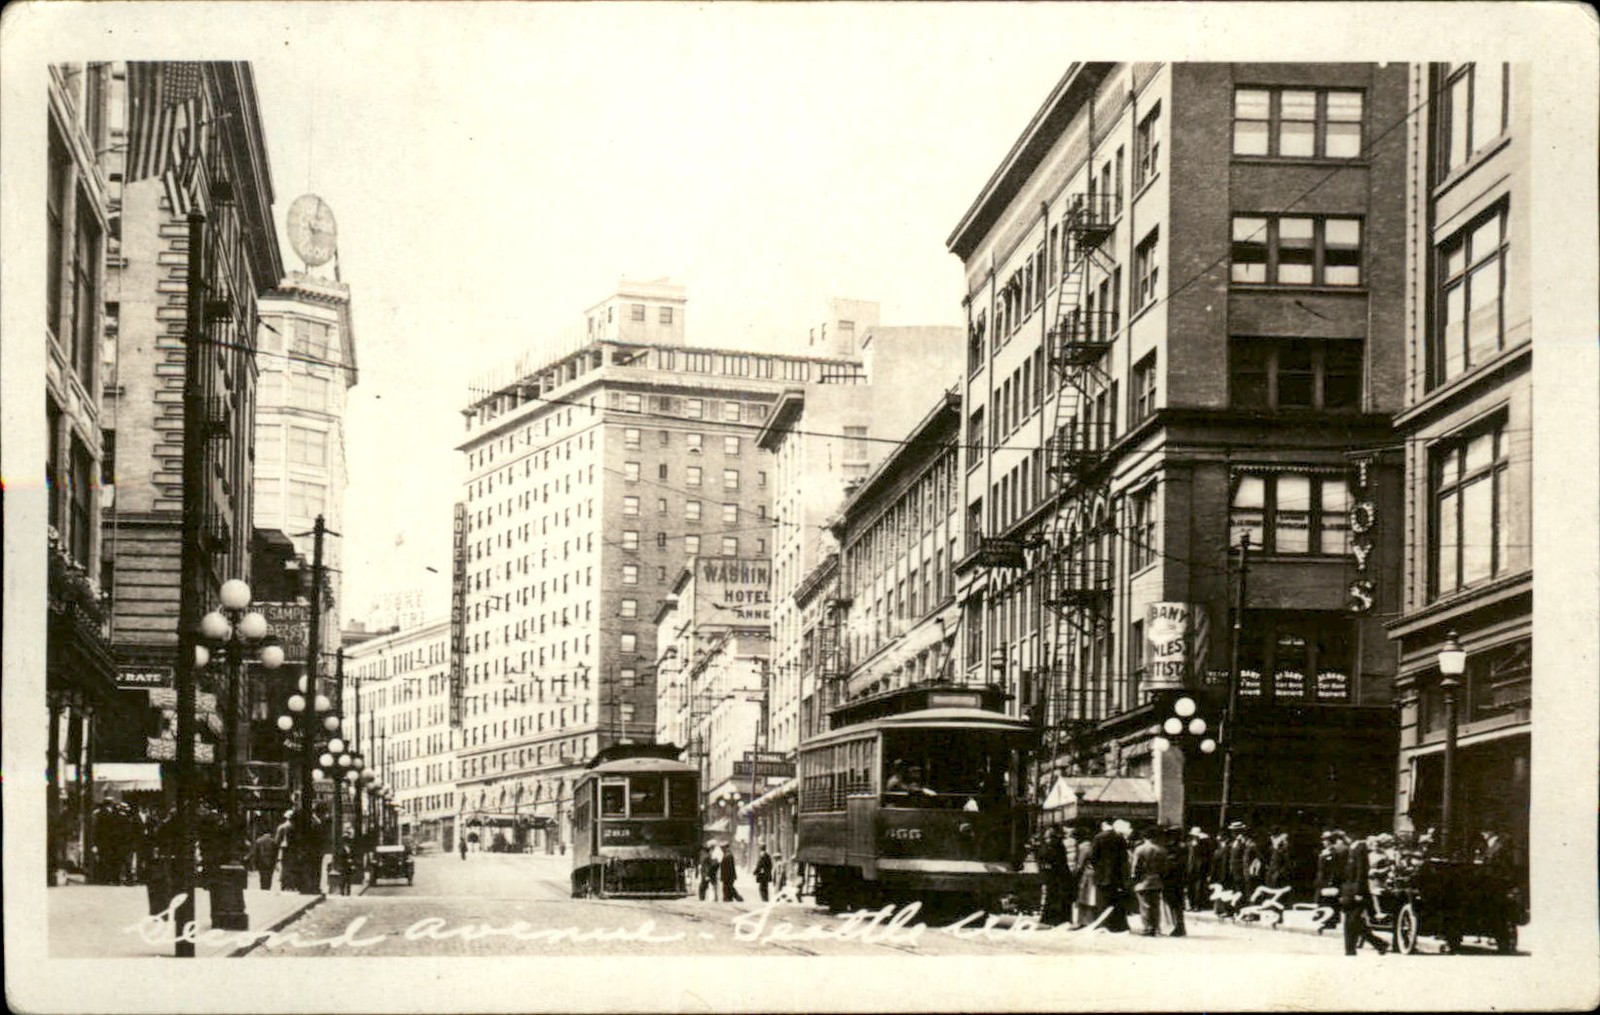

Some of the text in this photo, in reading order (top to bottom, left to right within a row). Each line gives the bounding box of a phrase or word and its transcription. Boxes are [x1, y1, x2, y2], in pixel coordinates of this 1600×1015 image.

[724, 589, 772, 603] HOTEL
[125, 672, 162, 682] RATE
[123, 892, 385, 948] Second
[733, 889, 926, 945] Seattle
